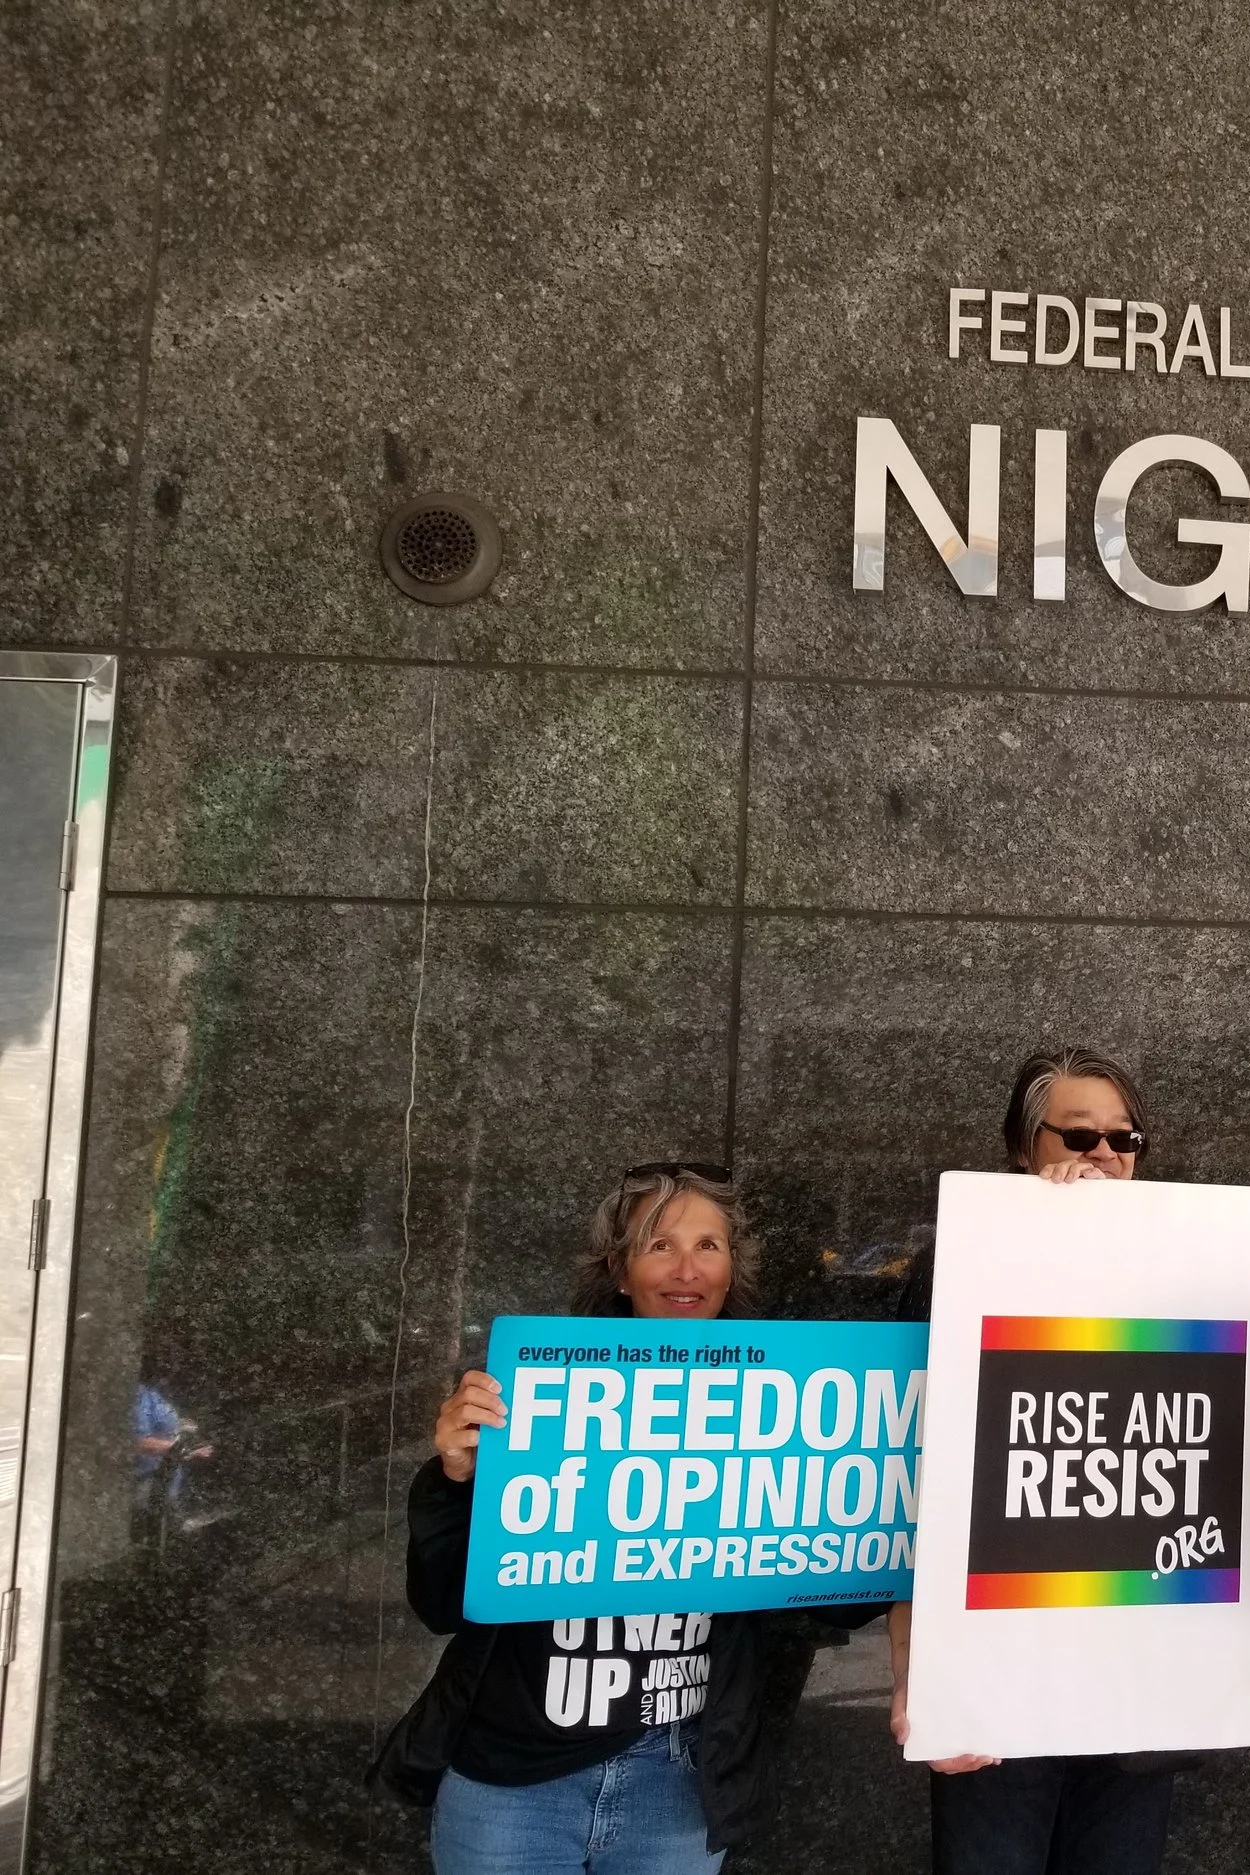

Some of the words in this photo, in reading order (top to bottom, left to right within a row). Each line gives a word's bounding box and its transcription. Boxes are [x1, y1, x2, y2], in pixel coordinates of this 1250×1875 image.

[518, 1345, 611, 1365] everyone
[617, 1345, 653, 1363] has
[658, 1345, 689, 1363] the
[695, 1345, 741, 1367] right
[746, 1346, 766, 1363] to
[507, 1367, 927, 1451] FREEDOM
[1009, 1391, 1109, 1444] RISE
[1123, 1392, 1212, 1444] AND
[500, 1456, 586, 1534] of
[607, 1454, 922, 1532] OPINION
[1005, 1448, 1210, 1518] RESIST
[497, 1540, 598, 1586] and
[613, 1531, 916, 1582] EXPRESSION
[1151, 1516, 1225, 1580] .ORG
[786, 1589, 895, 1604] riseandresist.org
[545, 1656, 631, 1728] UP
[641, 1652, 711, 1692] JUSTIN
[640, 1693, 654, 1726] AND
